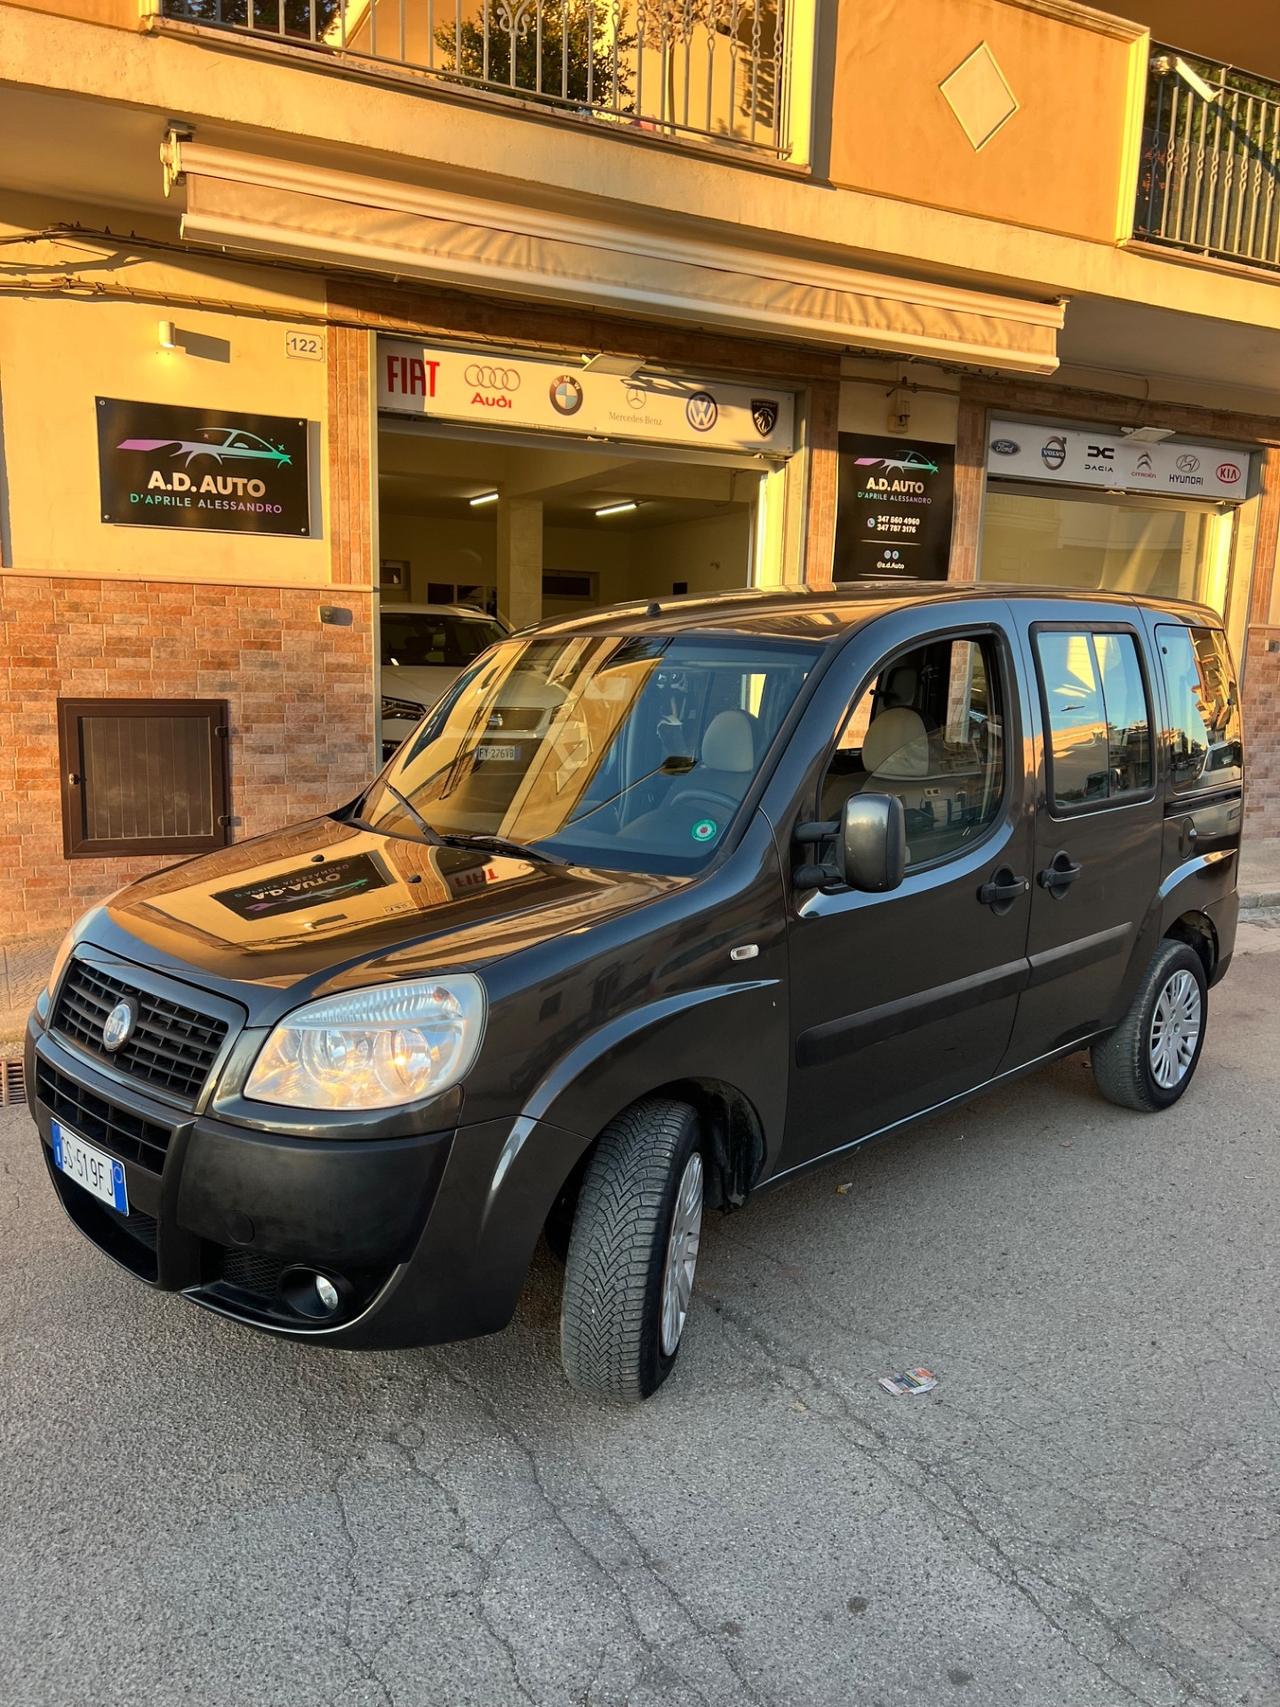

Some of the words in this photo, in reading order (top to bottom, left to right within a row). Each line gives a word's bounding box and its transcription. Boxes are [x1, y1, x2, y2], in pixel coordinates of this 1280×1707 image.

[291, 338, 317, 353] 122
[386, 355, 440, 397] FIAT
[470, 392, 512, 409] Audi
[609, 411, 644, 424] Mercedes
[1084, 464, 1114, 473] DACIA
[1220, 467, 1237, 480] KIA
[200, 475, 266, 498] AUTO
[1168, 473, 1204, 486] HYUNDAI
[892, 480, 925, 494] AUTO
[130, 493, 191, 508] D'APRILE
[198, 499, 283, 514] ALESSANDRO
[889, 495, 933, 505] ALESSANDRO
